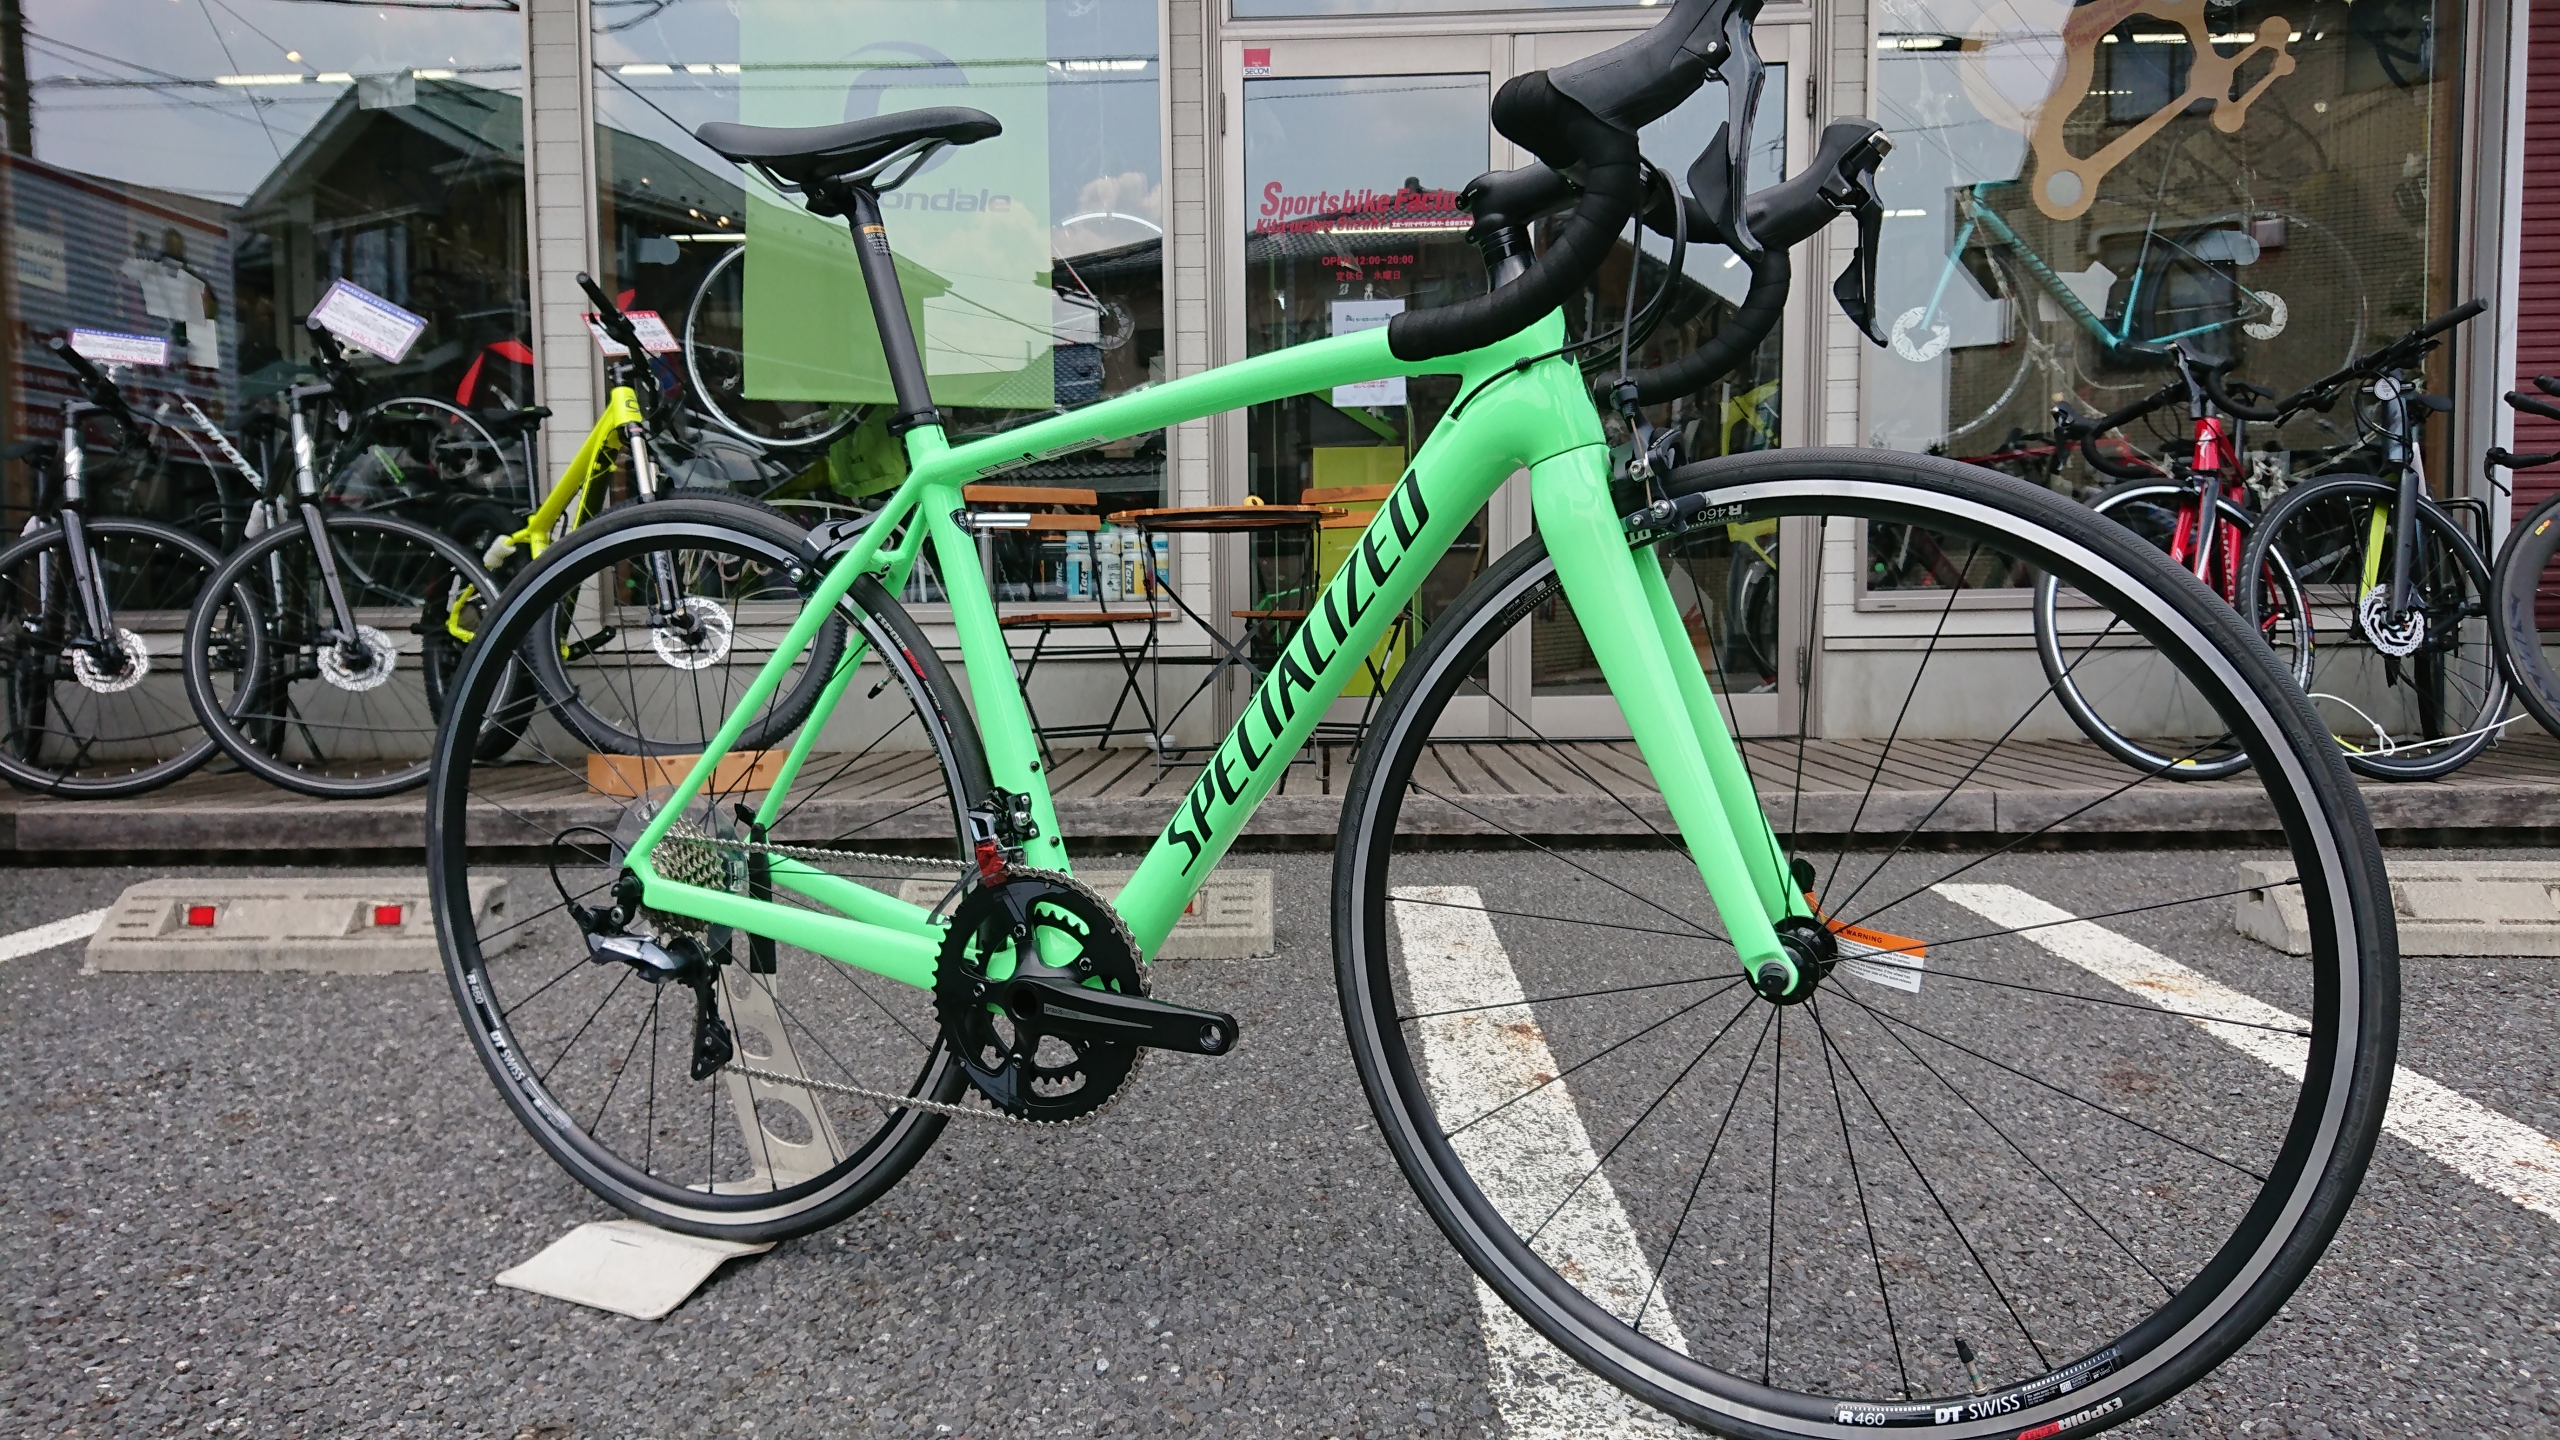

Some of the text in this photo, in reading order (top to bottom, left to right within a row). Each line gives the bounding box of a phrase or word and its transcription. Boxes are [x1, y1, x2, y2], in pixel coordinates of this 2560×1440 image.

[1245, 67, 1269, 75] SECOM
[1394, 188, 1459, 213] Facto
[1322, 256, 1352, 266] OPEN
[1336, 270, 1401, 281] 定休日 水曜日
[1125, 562, 1134, 592] Tacx
[875, 612, 908, 652] ESPOIR
[1168, 469, 1430, 876] SPECIALIZED
[1845, 929, 1883, 943] WARNING
[489, 1029, 526, 1082] DT SWISS
[1935, 1393, 2021, 1425] DT SWISS
[2058, 1396, 2124, 1432] ESPOIR
